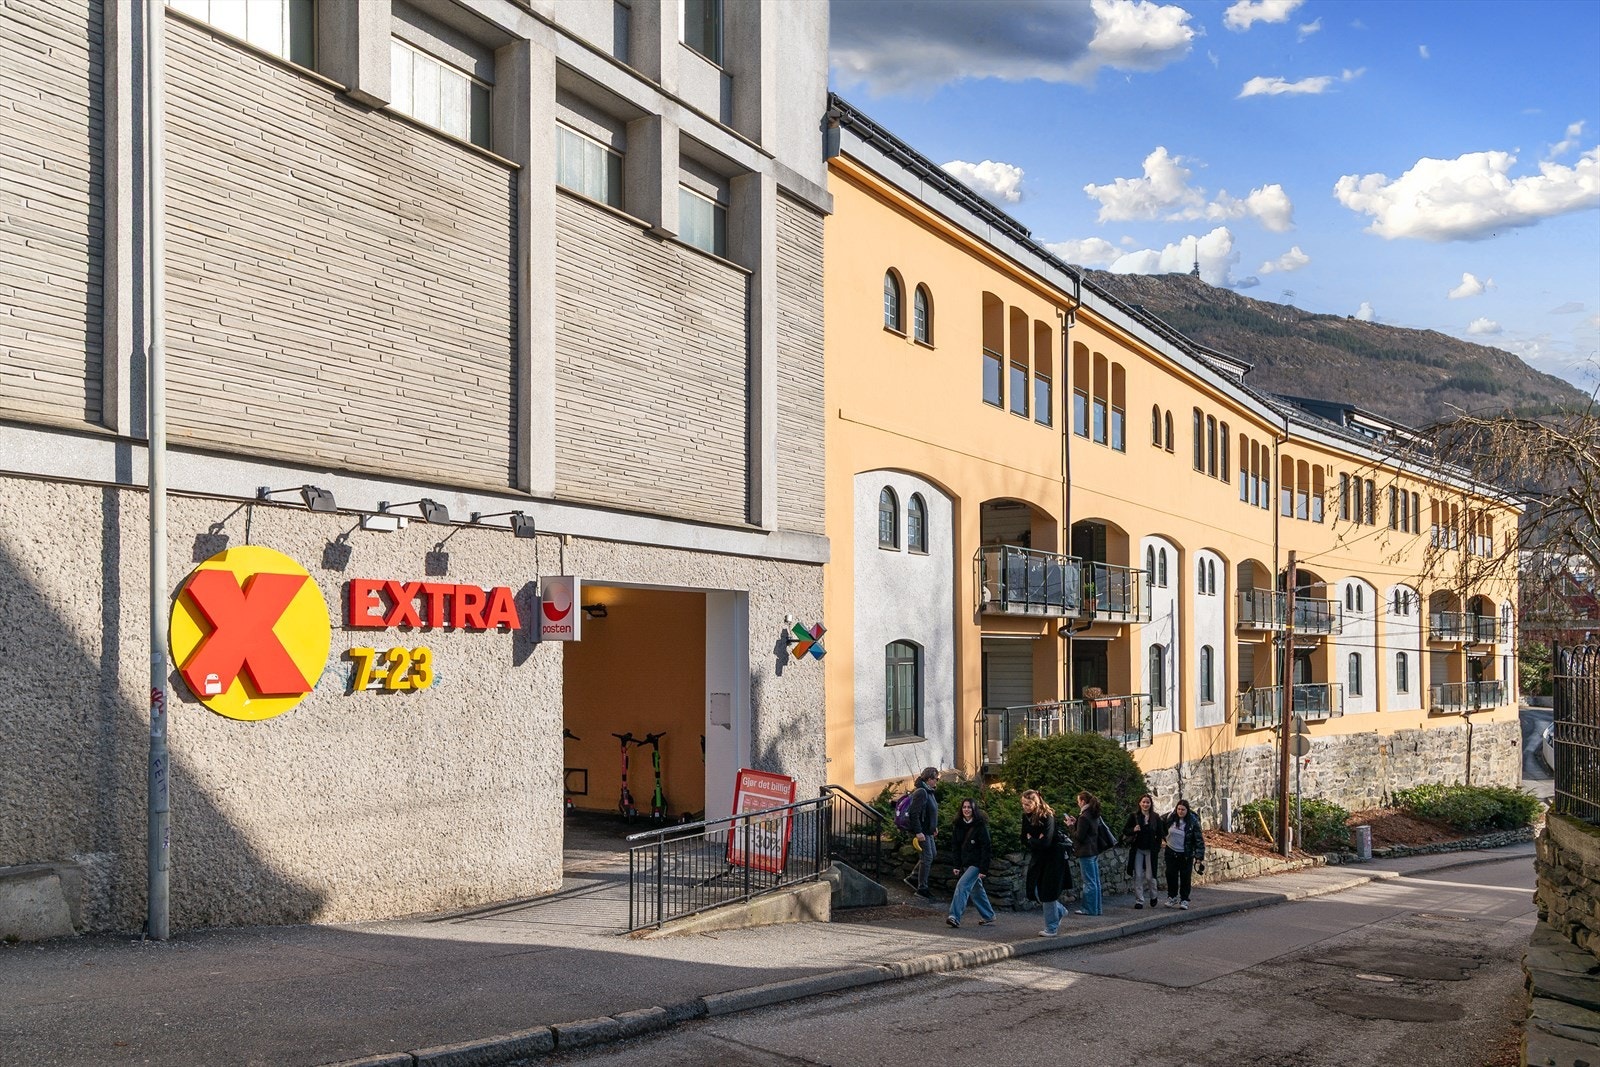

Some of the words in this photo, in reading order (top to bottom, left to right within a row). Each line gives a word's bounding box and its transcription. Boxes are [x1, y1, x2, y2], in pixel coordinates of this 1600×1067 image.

[350, 578, 521, 629] EXTRA
[542, 624, 572, 635] posten
[350, 647, 433, 691] 7-23
[742, 776, 758, 788] Gjør
[758, 779, 770, 790] det
[771, 781, 791, 795] billig!
